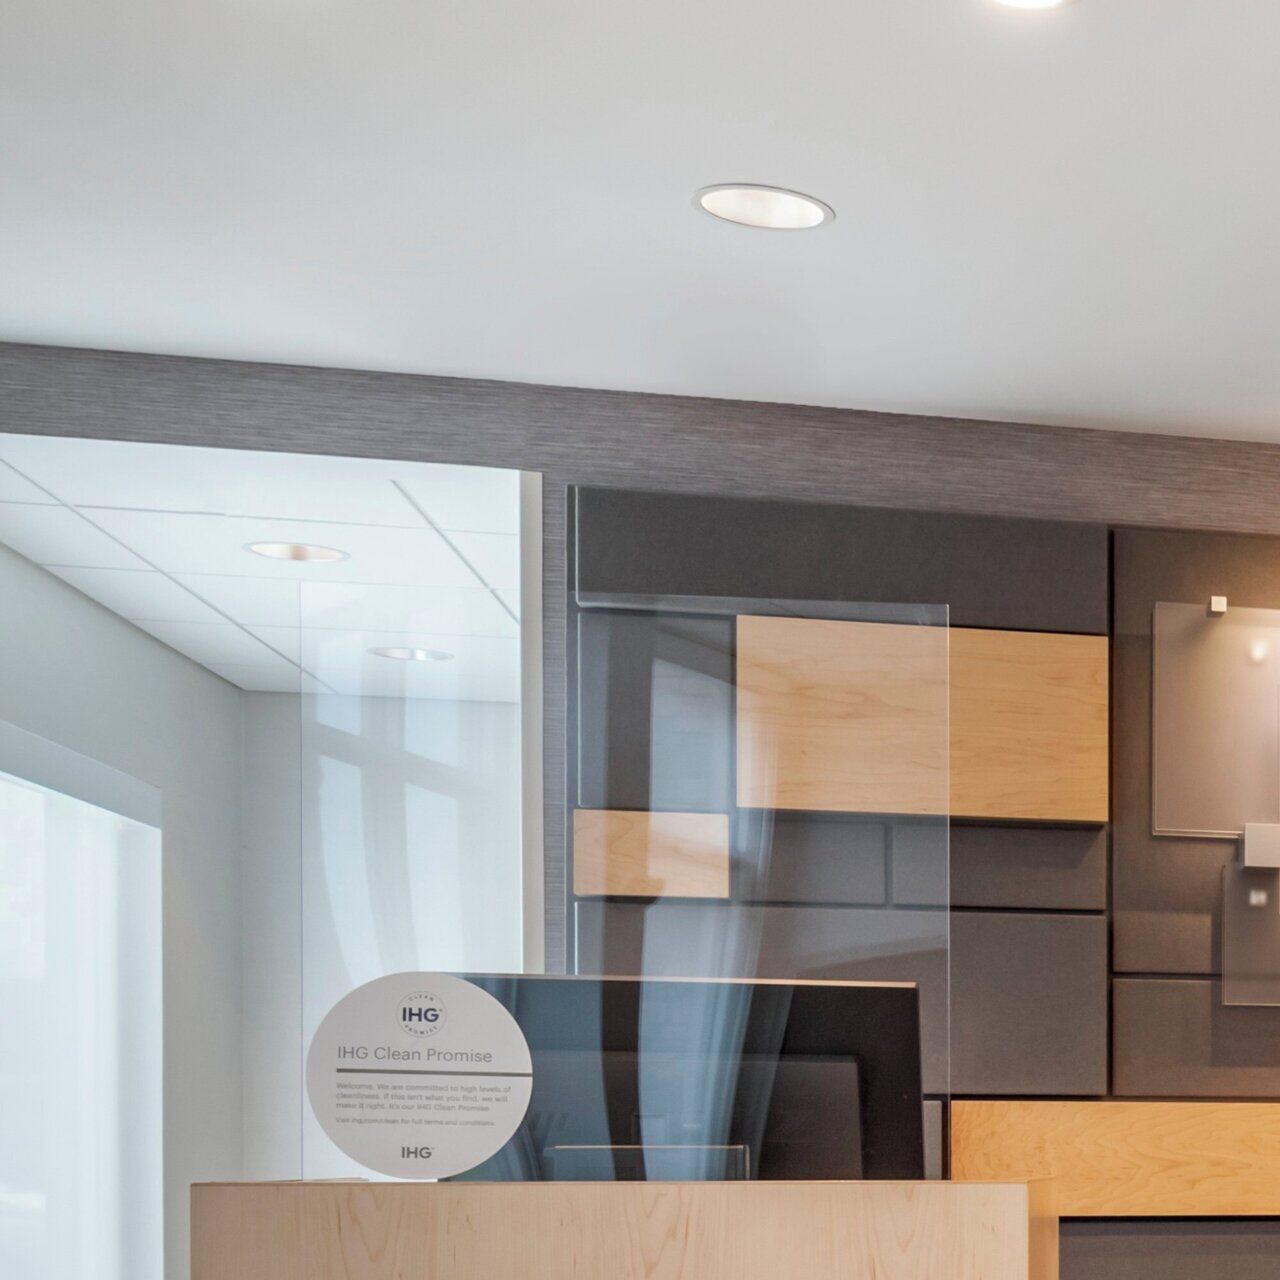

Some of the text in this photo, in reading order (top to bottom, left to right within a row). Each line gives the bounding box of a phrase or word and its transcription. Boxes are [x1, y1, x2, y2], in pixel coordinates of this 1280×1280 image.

[402, 1007, 440, 1022] IHG
[338, 1046, 492, 1062] IHG Clean Promise
[401, 1146, 432, 1159] IHG
